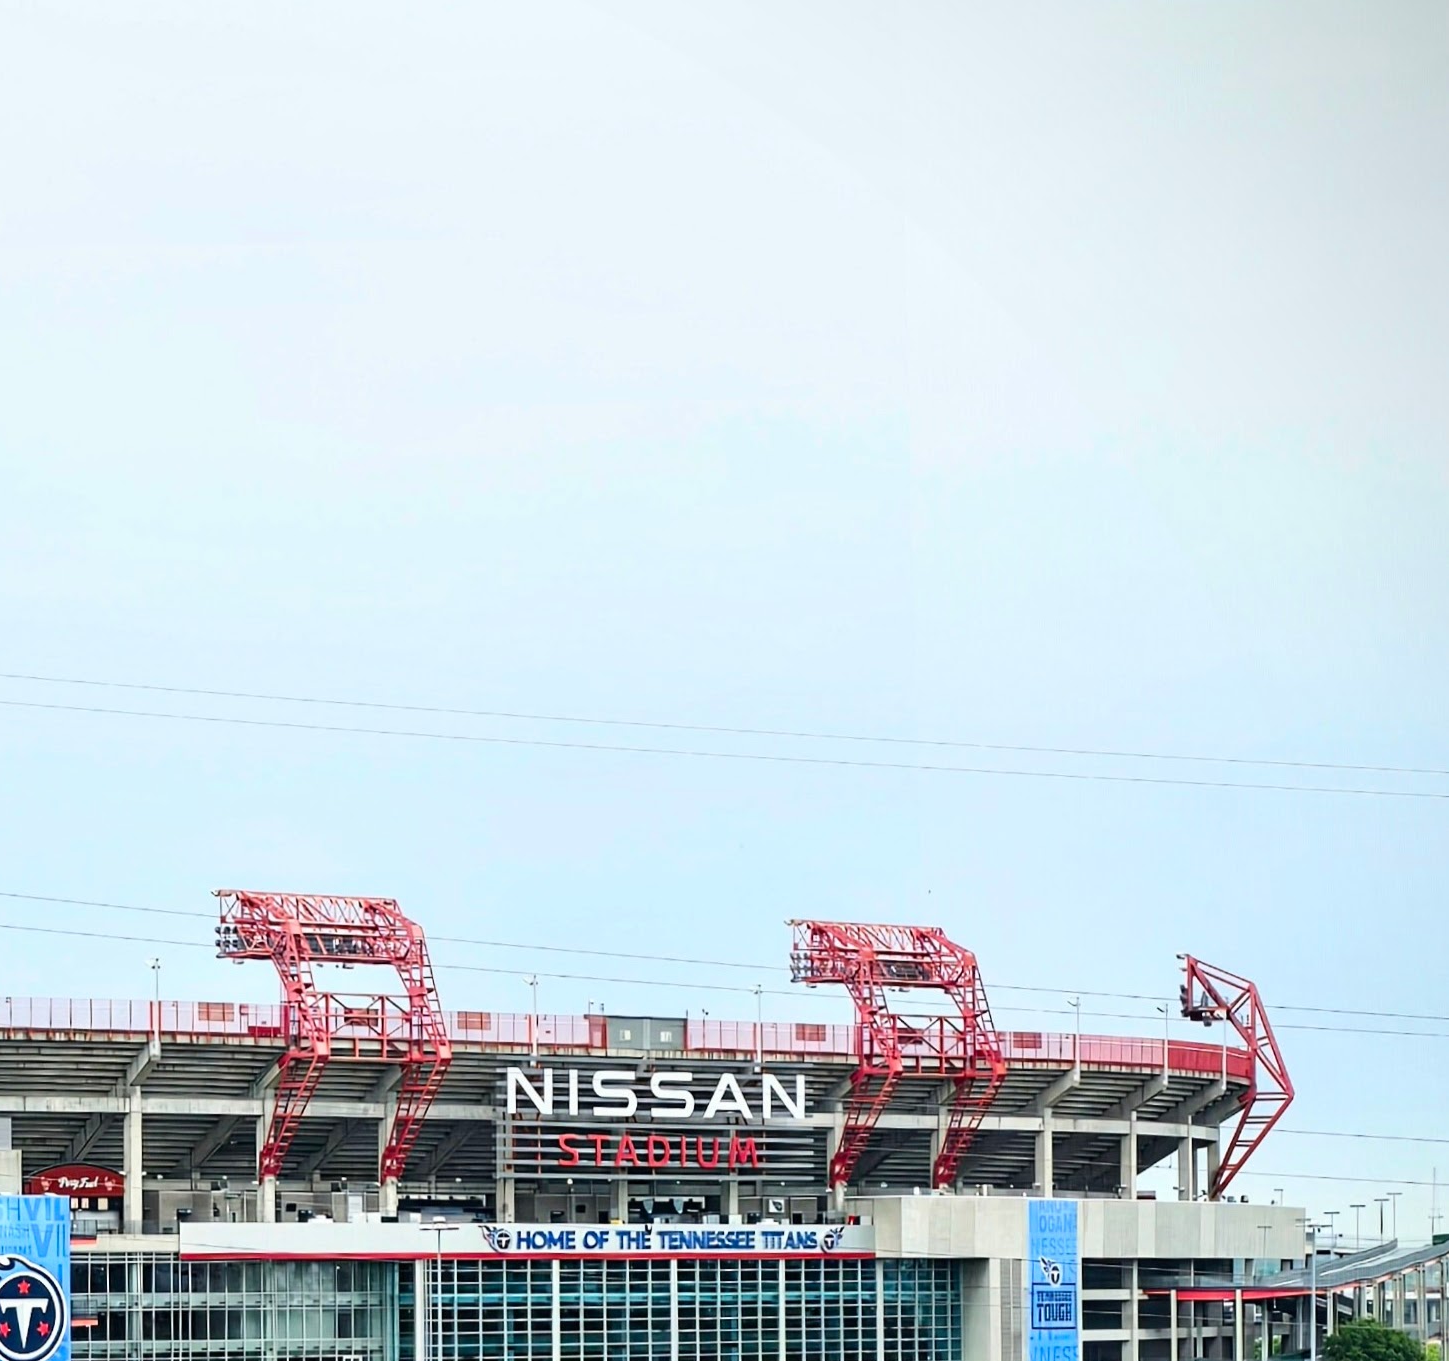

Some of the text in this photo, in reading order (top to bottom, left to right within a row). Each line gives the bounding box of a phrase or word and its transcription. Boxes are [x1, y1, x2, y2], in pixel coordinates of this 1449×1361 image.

[506, 1066, 806, 1119] NISSAN
[557, 1133, 760, 1168] STADIUM
[516, 1230, 818, 1250] HOME OF THE TENNESSEE TITANS
[1036, 1303, 1073, 1323] TOUGH
